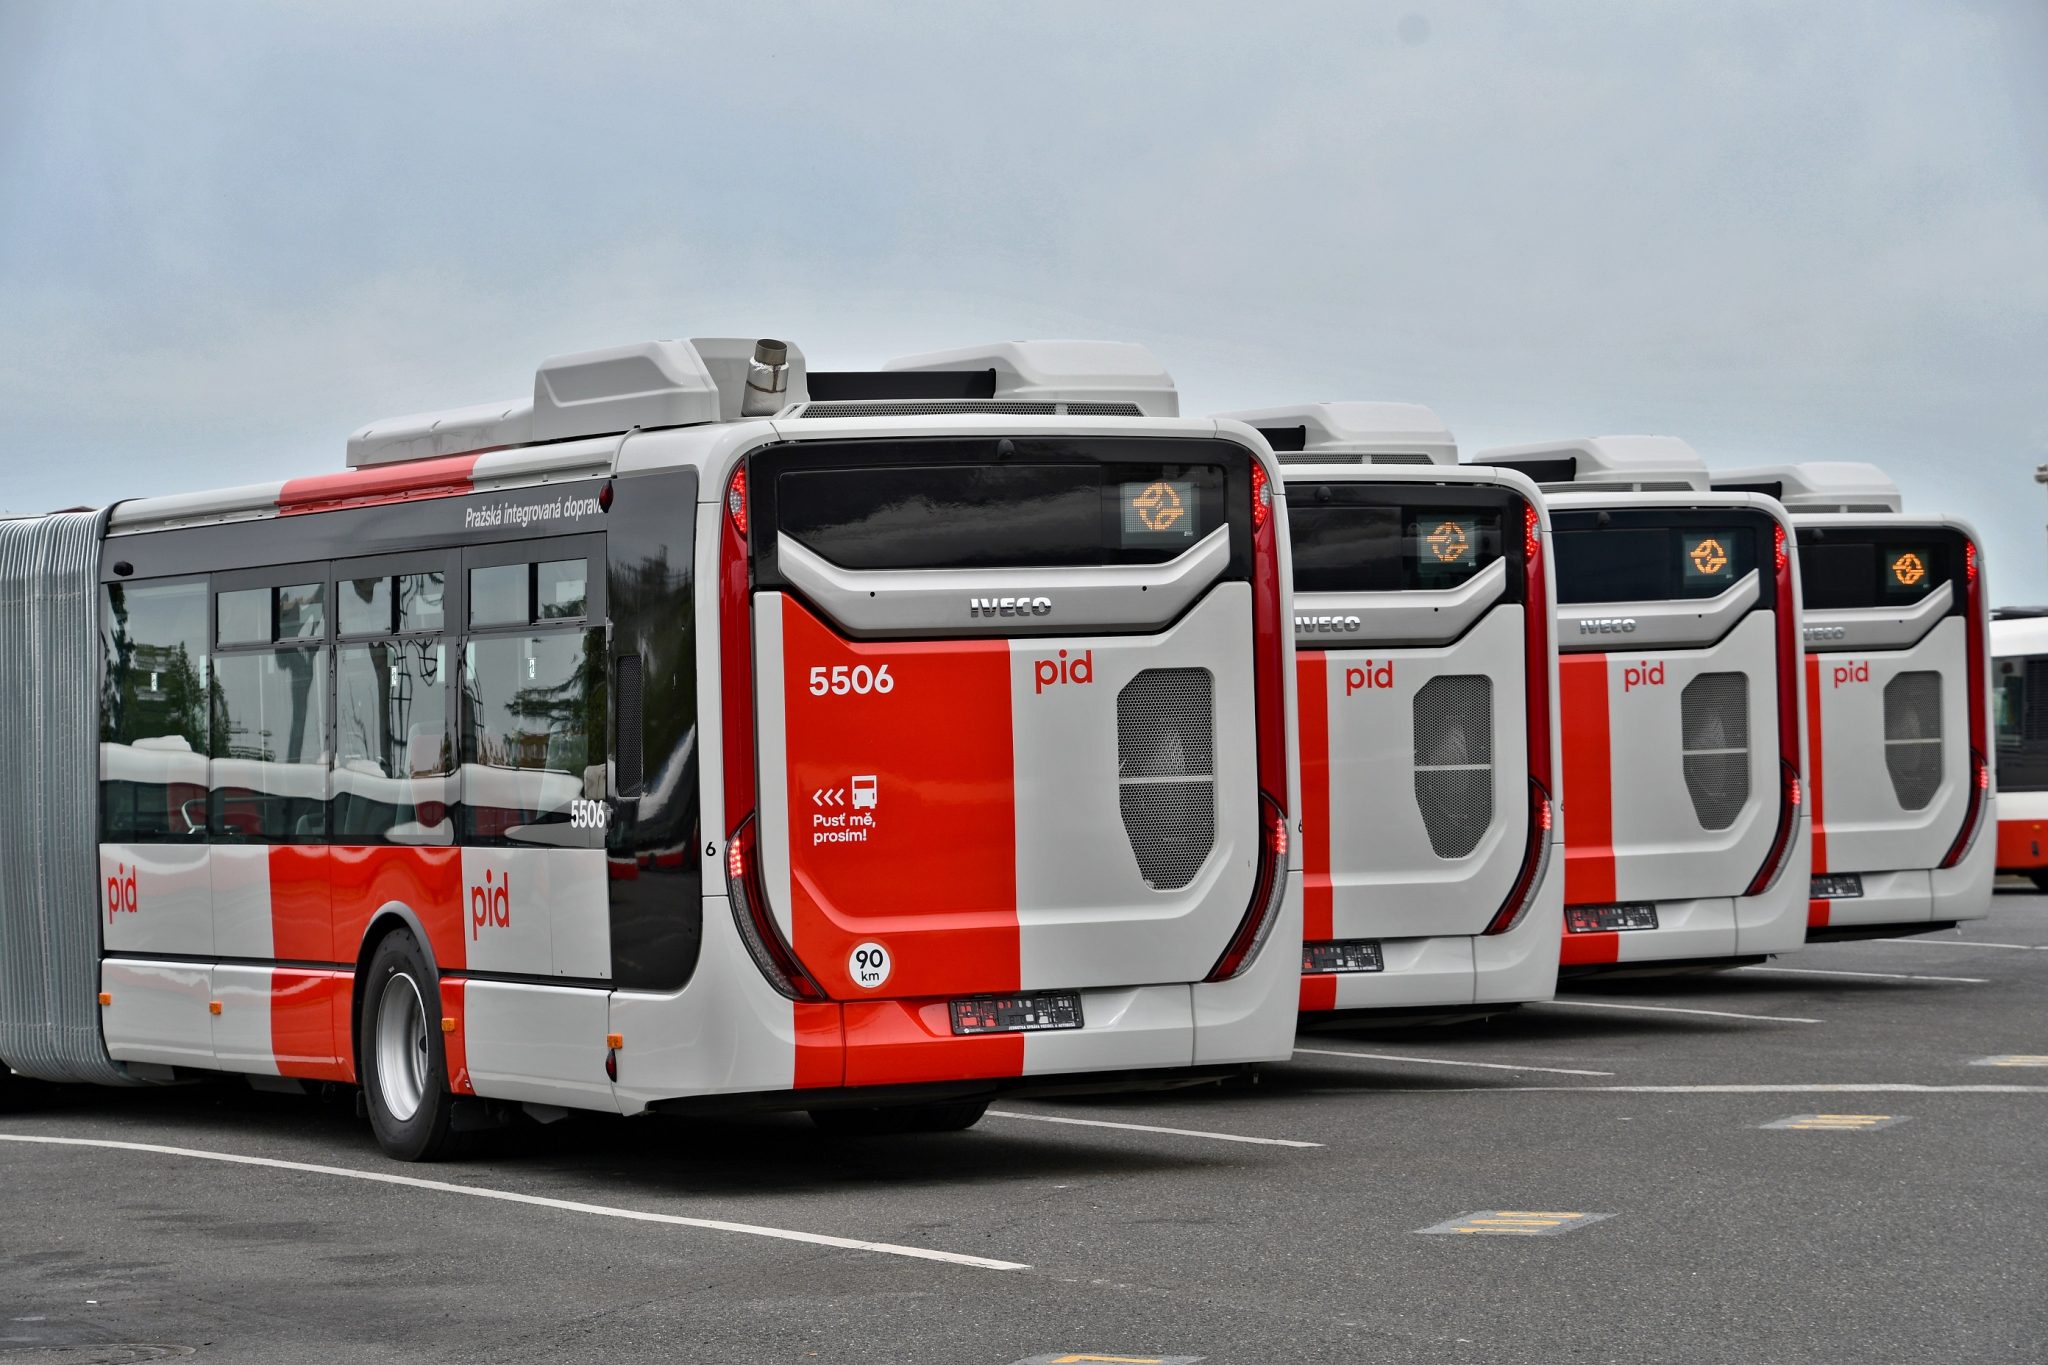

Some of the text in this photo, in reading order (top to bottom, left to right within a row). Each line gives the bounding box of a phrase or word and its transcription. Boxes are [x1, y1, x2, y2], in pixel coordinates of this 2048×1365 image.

[465, 503, 501, 528] Pražská
[503, 497, 562, 527] integrovaná
[970, 597, 1052, 618] IVECO
[1294, 616, 1361, 633] IVECO
[1580, 618, 1636, 634] IVECO
[1803, 626, 1845, 641] VECO
[808, 664, 894, 696] 5506
[1034, 649, 1093, 694] pid
[1346, 659, 1393, 697] pid
[1624, 660, 1664, 692] pid
[1833, 660, 1869, 689] pid
[571, 800, 605, 828] 5506
[813, 812, 876, 828] Pusť mě,
[705, 841, 716, 857] 6
[813, 828, 867, 846] prosím!
[107, 862, 138, 925] pid
[471, 869, 510, 941] pid
[855, 948, 884, 969] 90
[861, 970, 880, 982] km
